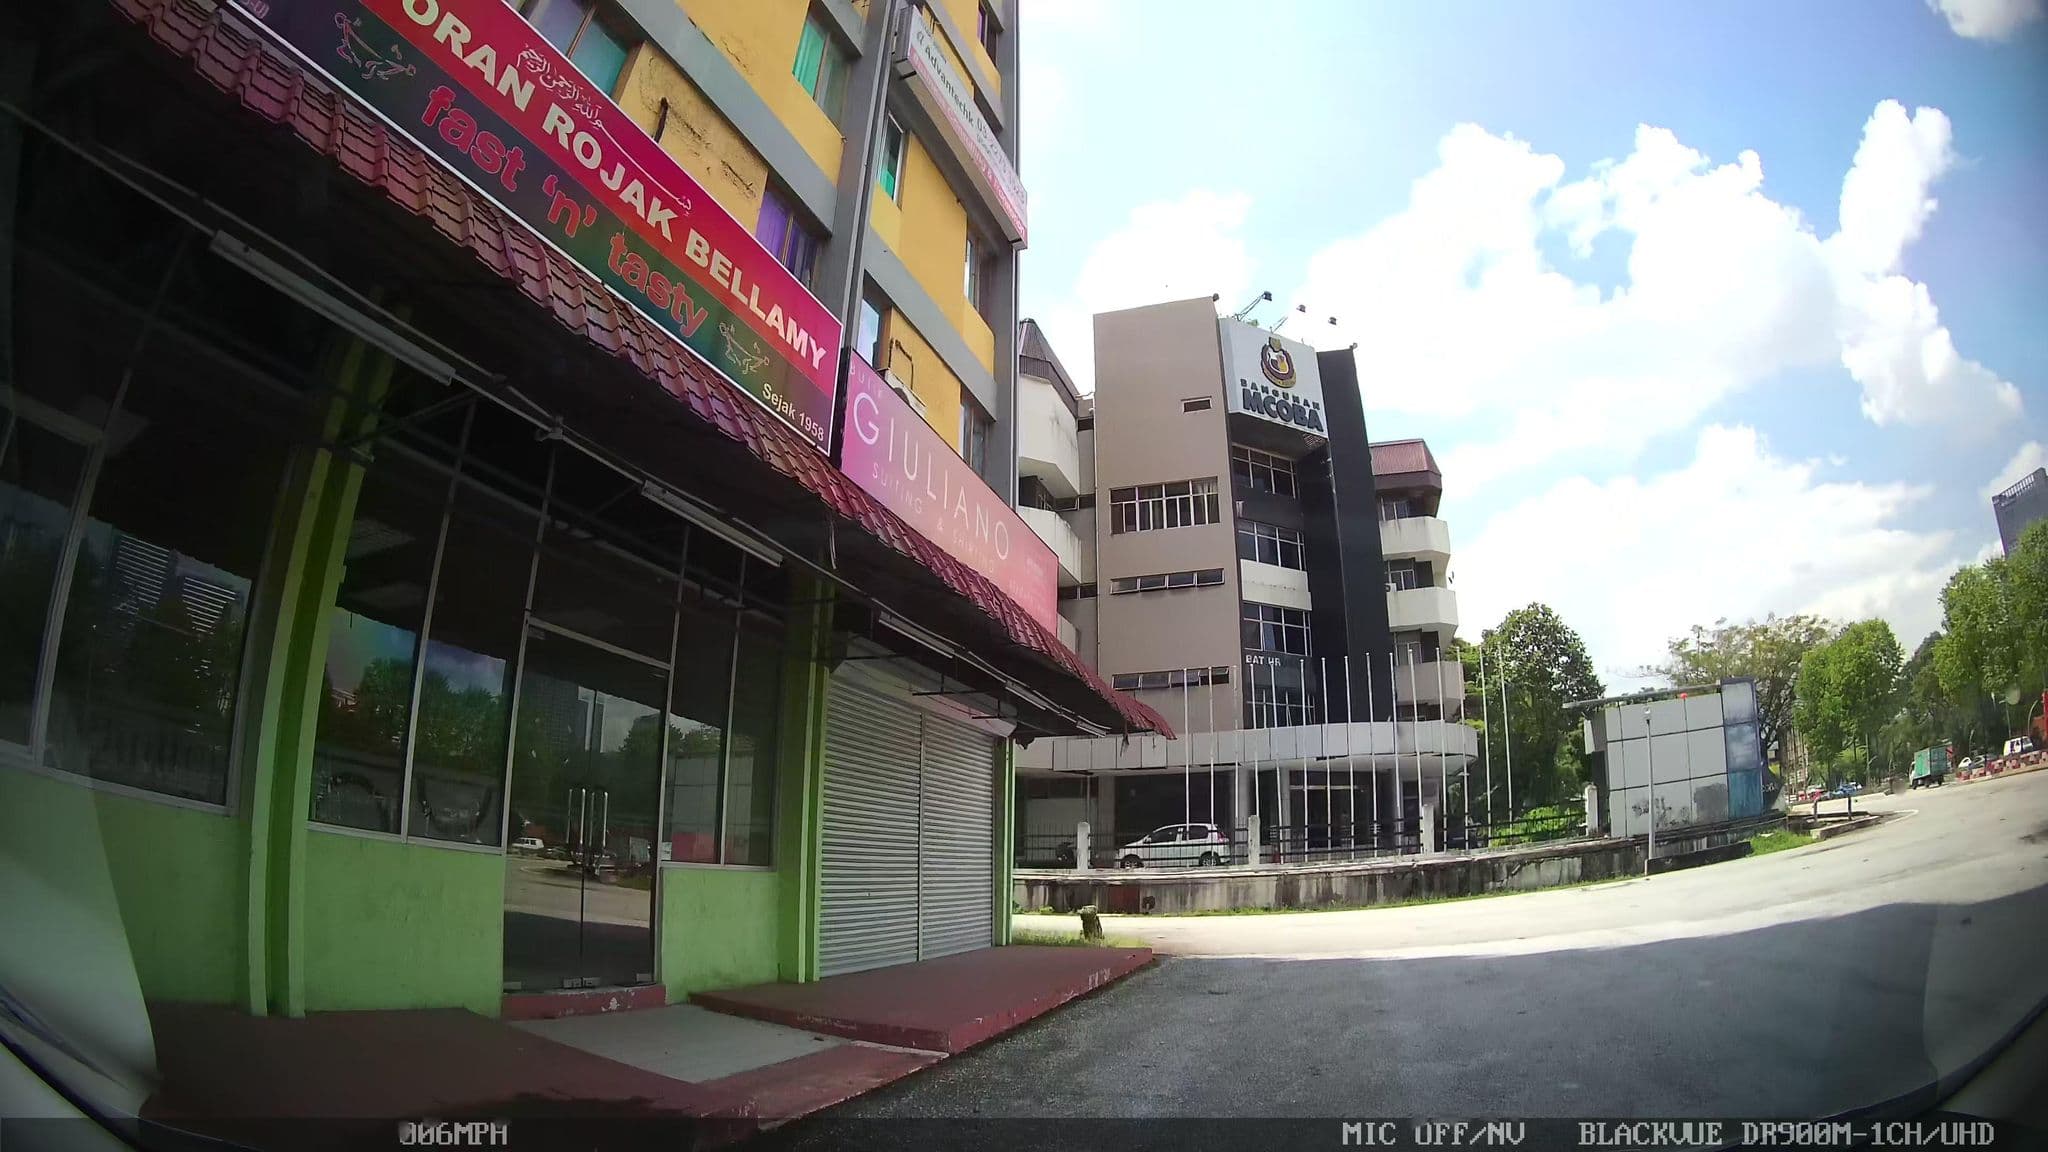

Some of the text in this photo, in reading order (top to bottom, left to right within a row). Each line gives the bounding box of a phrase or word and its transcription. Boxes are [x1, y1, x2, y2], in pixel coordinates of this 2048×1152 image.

[421, 85, 527, 192] fast
[607, 231, 709, 338] tasty
[542, 102, 678, 243] ROJAK
[685, 228, 828, 370] BELLAMY
[762, 382, 825, 442] Sejak 1958
[853, 392, 1010, 560] GIULIANO
[1242, 388, 1324, 432] MCOBA
